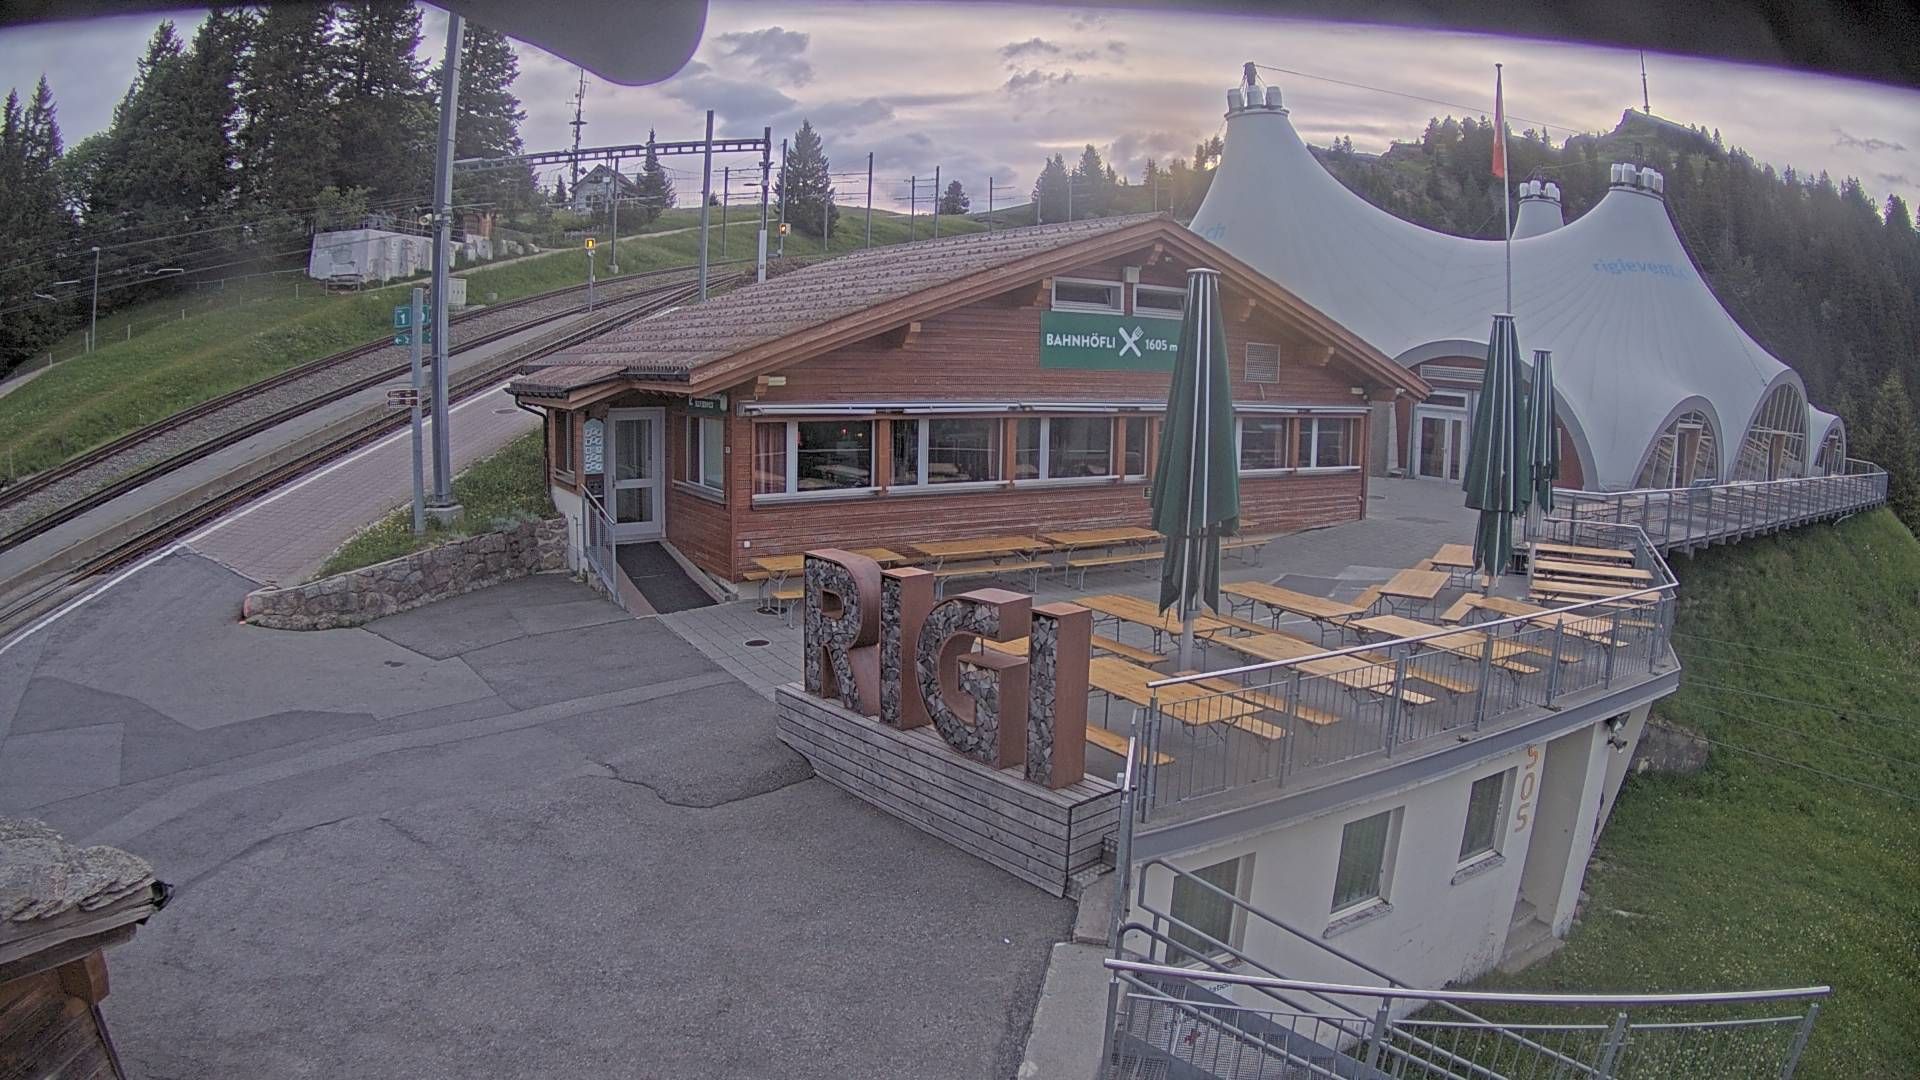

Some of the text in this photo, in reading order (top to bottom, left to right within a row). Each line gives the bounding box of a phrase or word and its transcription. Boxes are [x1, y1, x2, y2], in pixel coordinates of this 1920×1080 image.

[1046, 332, 1178, 352] BAHNHÖFLI 1605 m
[804, 549, 1091, 790] RIGI
[1514, 743, 1539, 833] SOS
